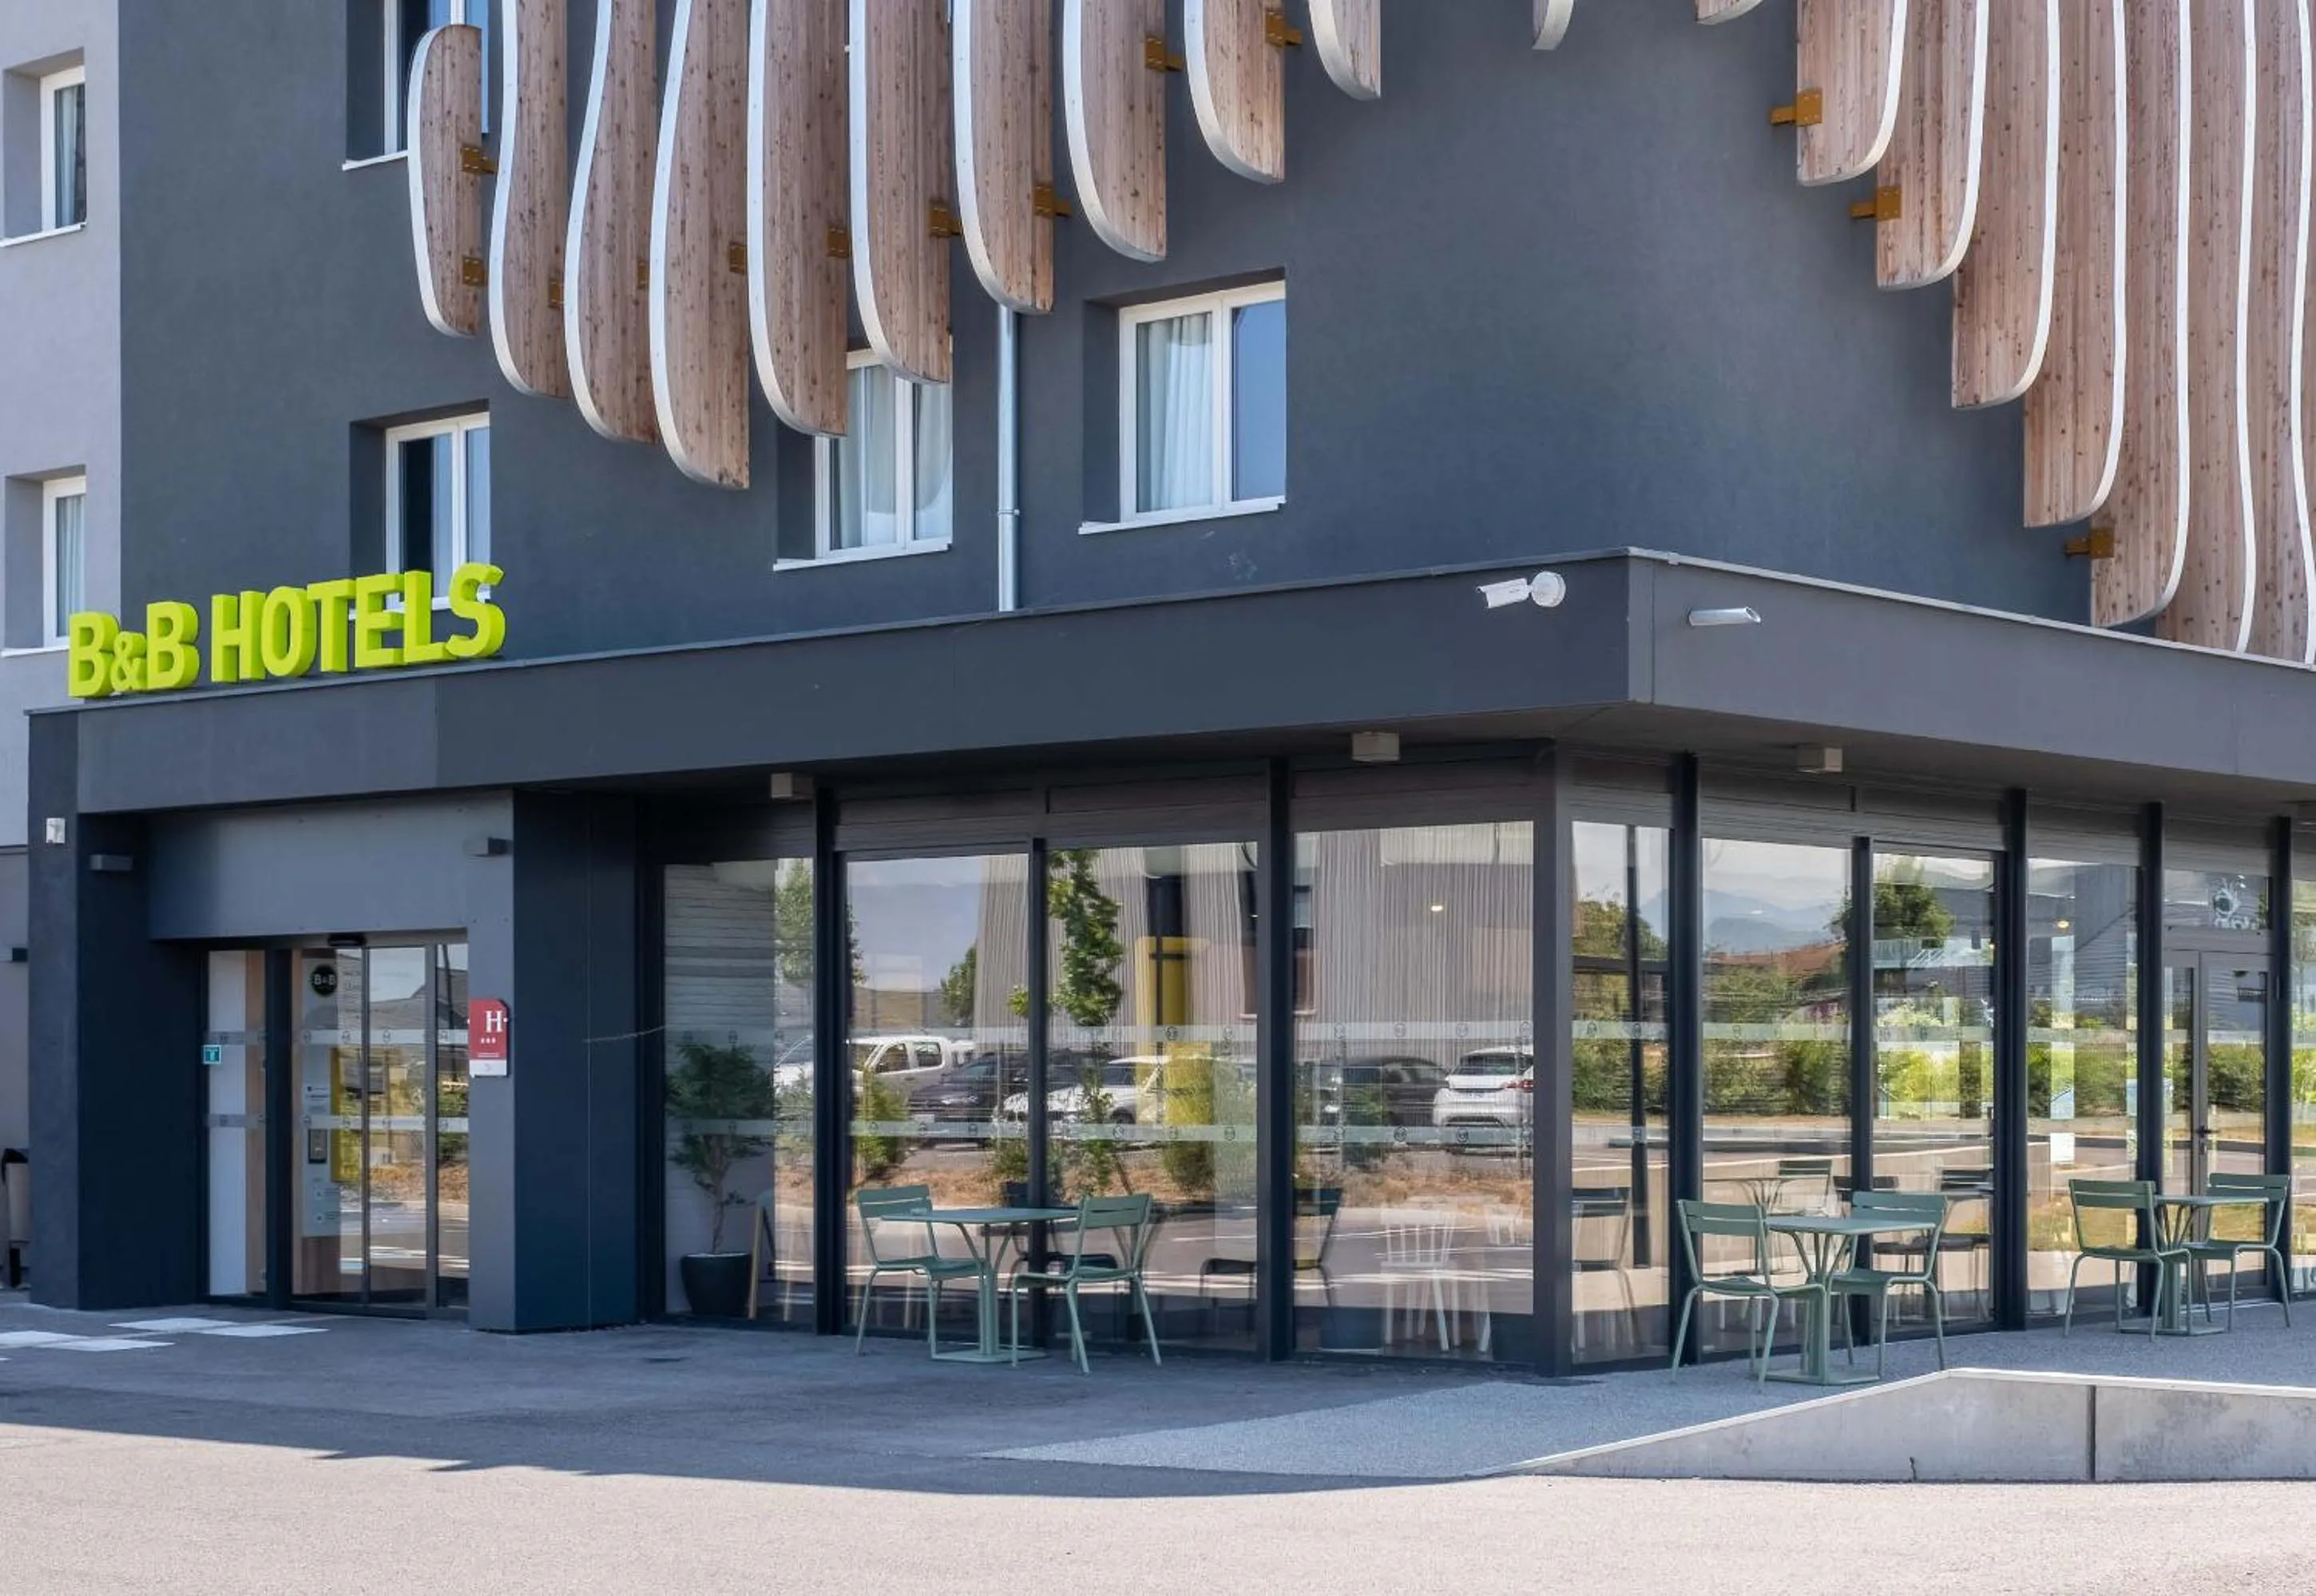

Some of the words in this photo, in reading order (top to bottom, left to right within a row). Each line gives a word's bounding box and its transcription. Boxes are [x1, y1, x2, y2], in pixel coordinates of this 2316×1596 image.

[69, 601, 200, 699] B&B
[211, 562, 506, 683] HOTELS
[485, 1010, 503, 1033] H
